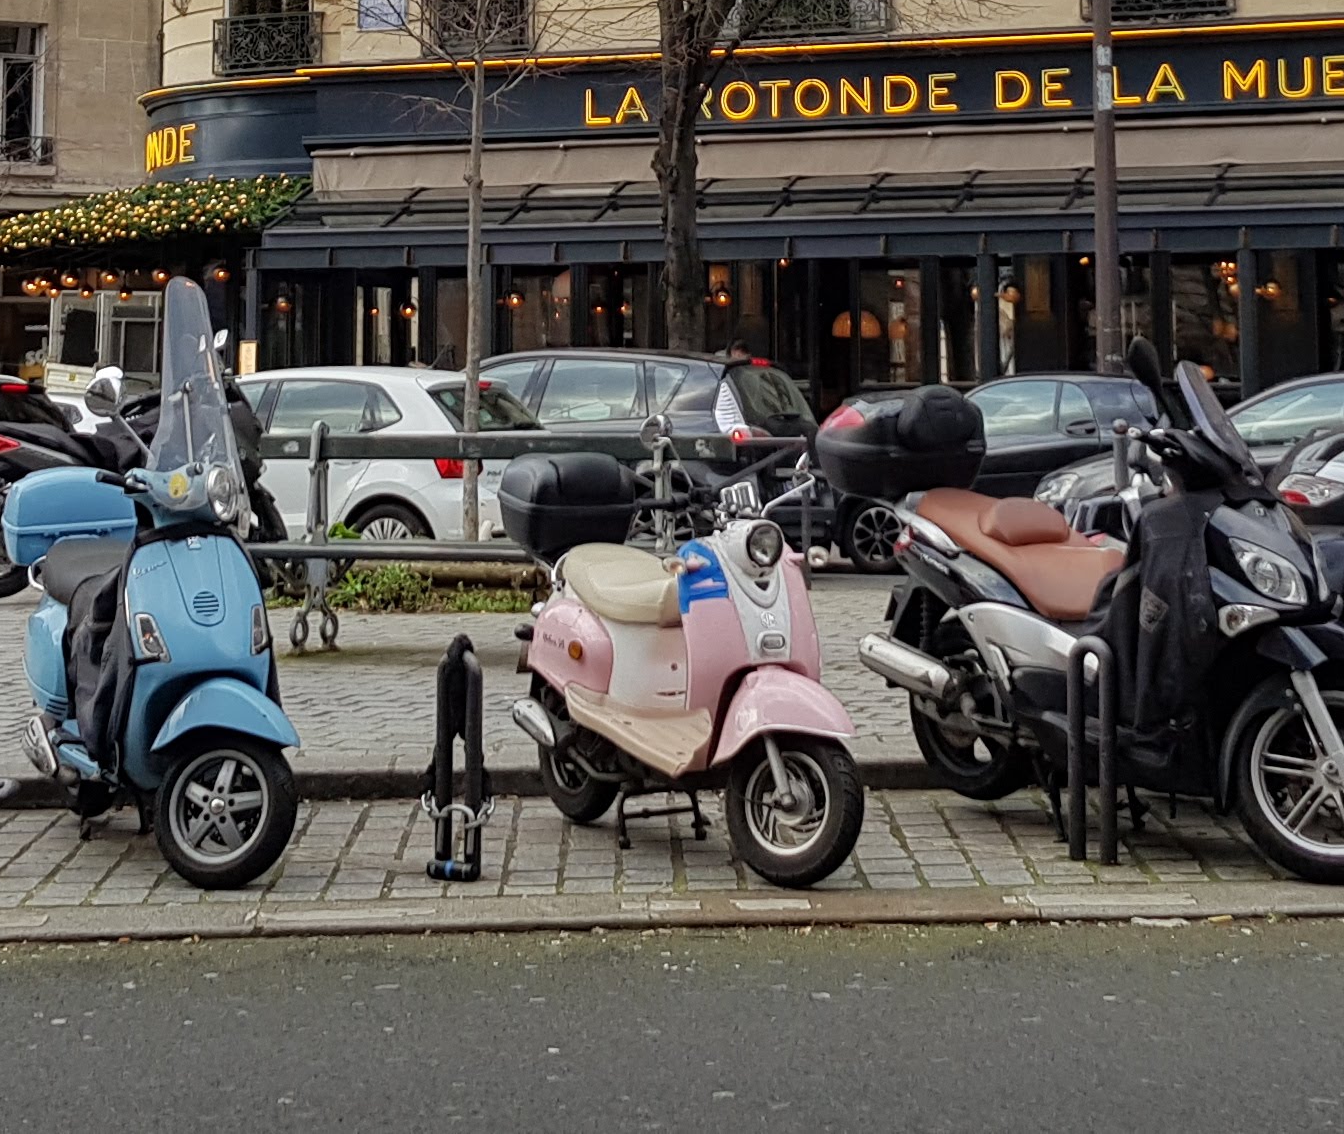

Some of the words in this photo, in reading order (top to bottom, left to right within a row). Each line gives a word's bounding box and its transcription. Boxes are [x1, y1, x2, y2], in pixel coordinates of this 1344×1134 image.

[585, 86, 649, 126] LA
[994, 68, 1072, 108] DE
[1111, 63, 1186, 105] LA
